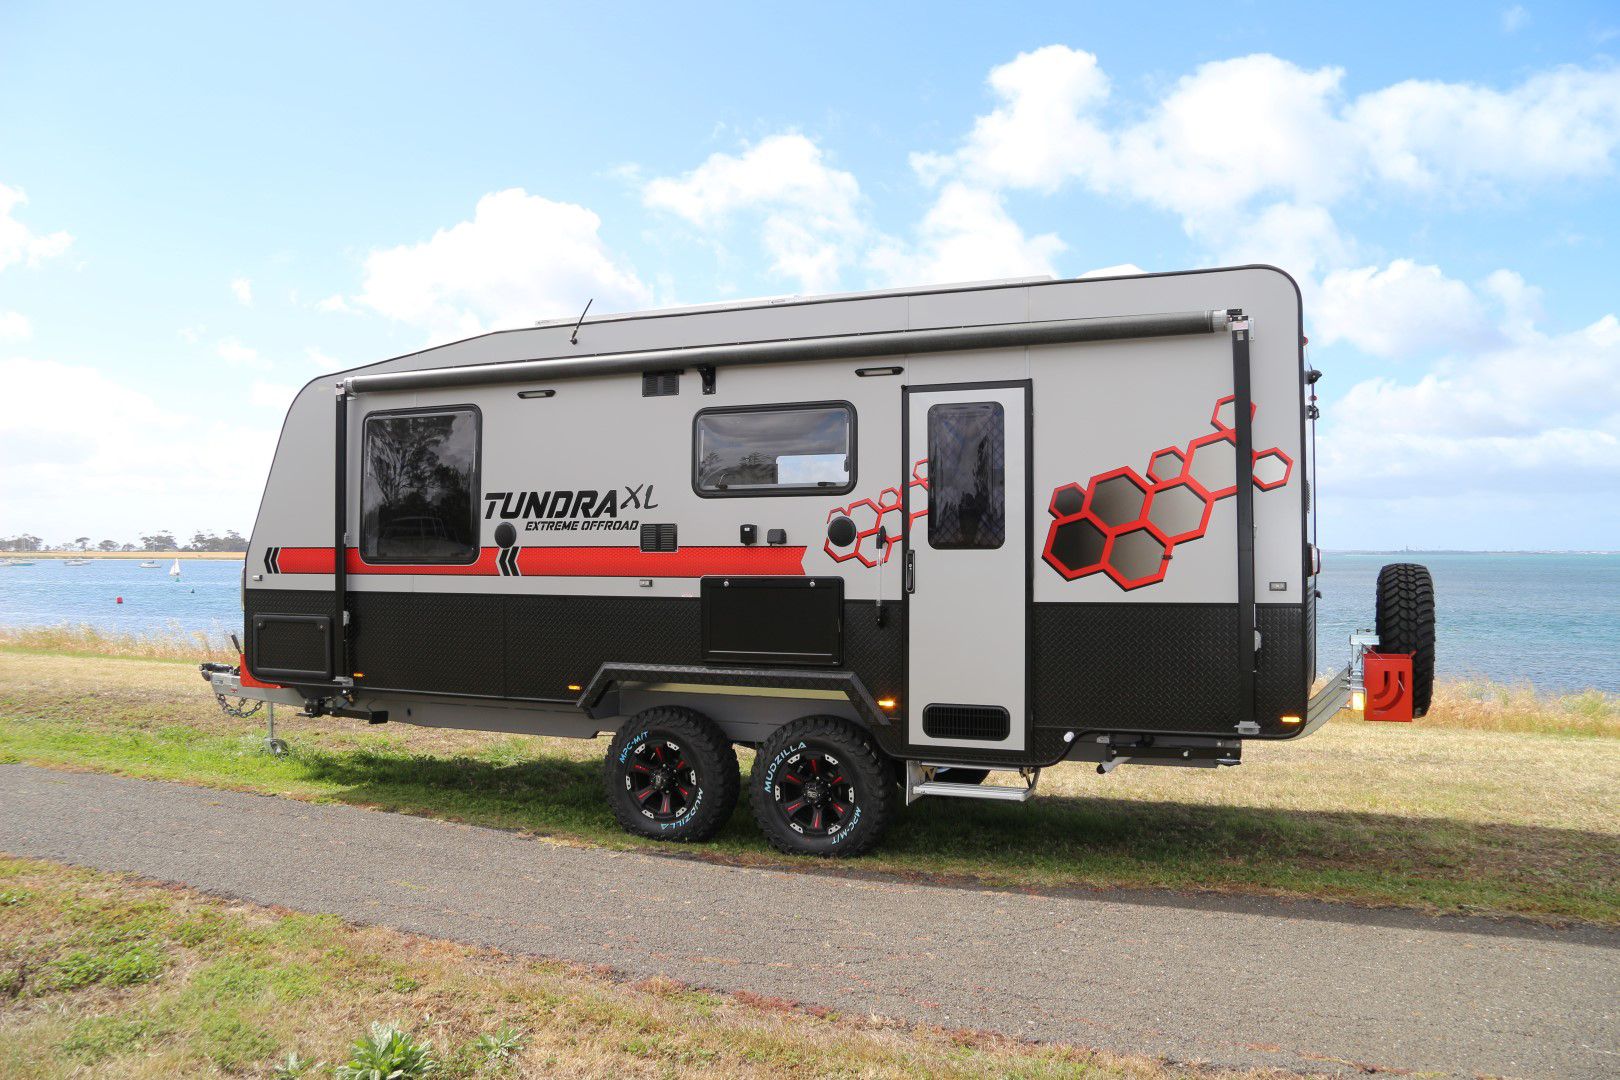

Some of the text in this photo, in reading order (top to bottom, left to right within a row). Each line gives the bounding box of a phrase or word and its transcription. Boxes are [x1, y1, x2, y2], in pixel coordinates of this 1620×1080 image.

[485, 483, 658, 520] TUNDRA XL
[525, 520, 639, 531] EXTREME OFFROAD
[764, 741, 807, 793] MUDZILLA
[660, 787, 704, 830] MUDZILLA
